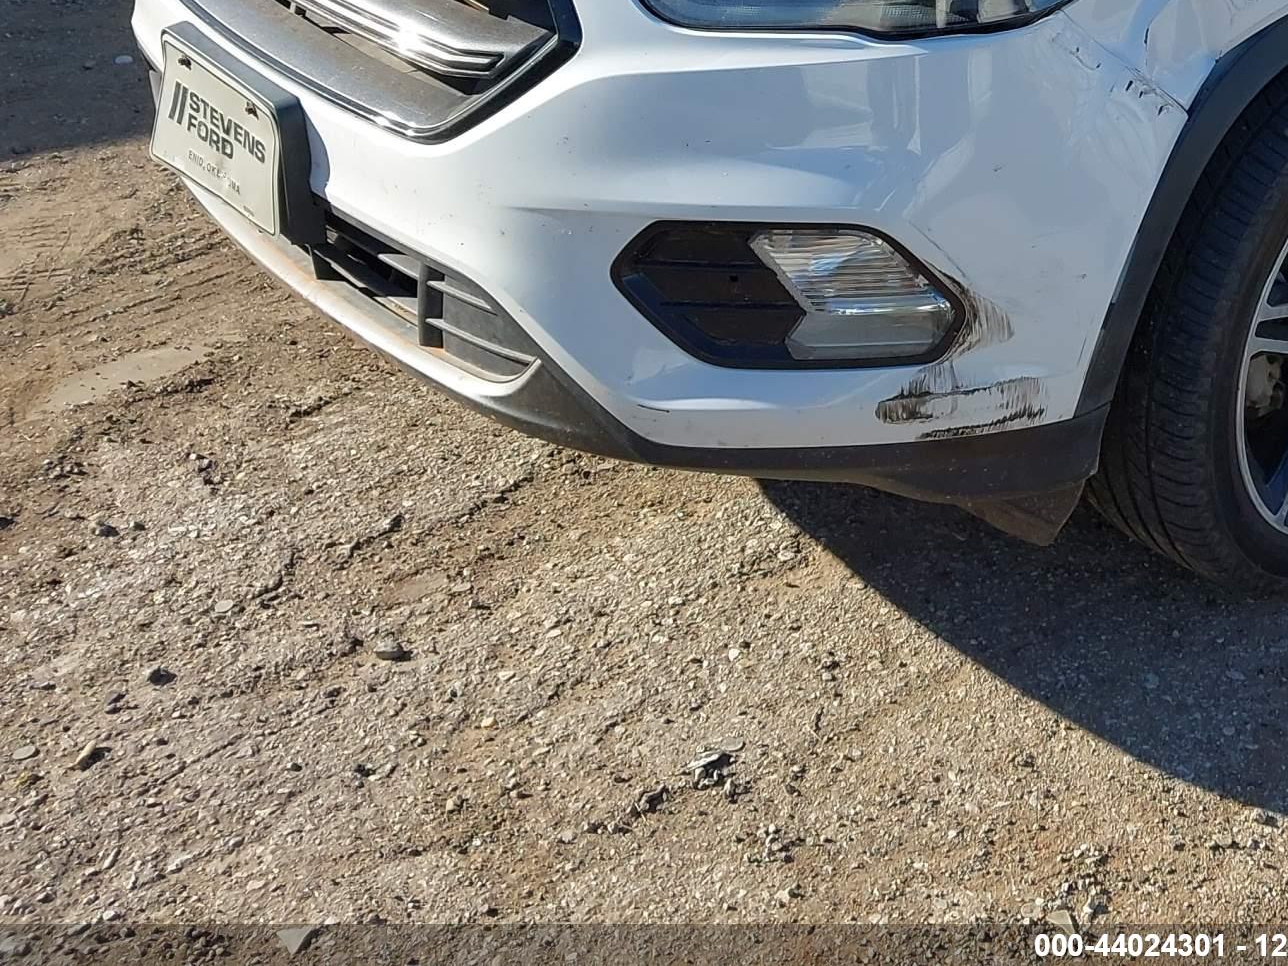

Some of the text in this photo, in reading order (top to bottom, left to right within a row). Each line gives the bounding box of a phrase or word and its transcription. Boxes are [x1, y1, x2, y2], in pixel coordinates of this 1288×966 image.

[187, 113, 235, 160] FORD
[189, 92, 266, 164] STEVENS
[206, 163, 241, 196] OKLMA
